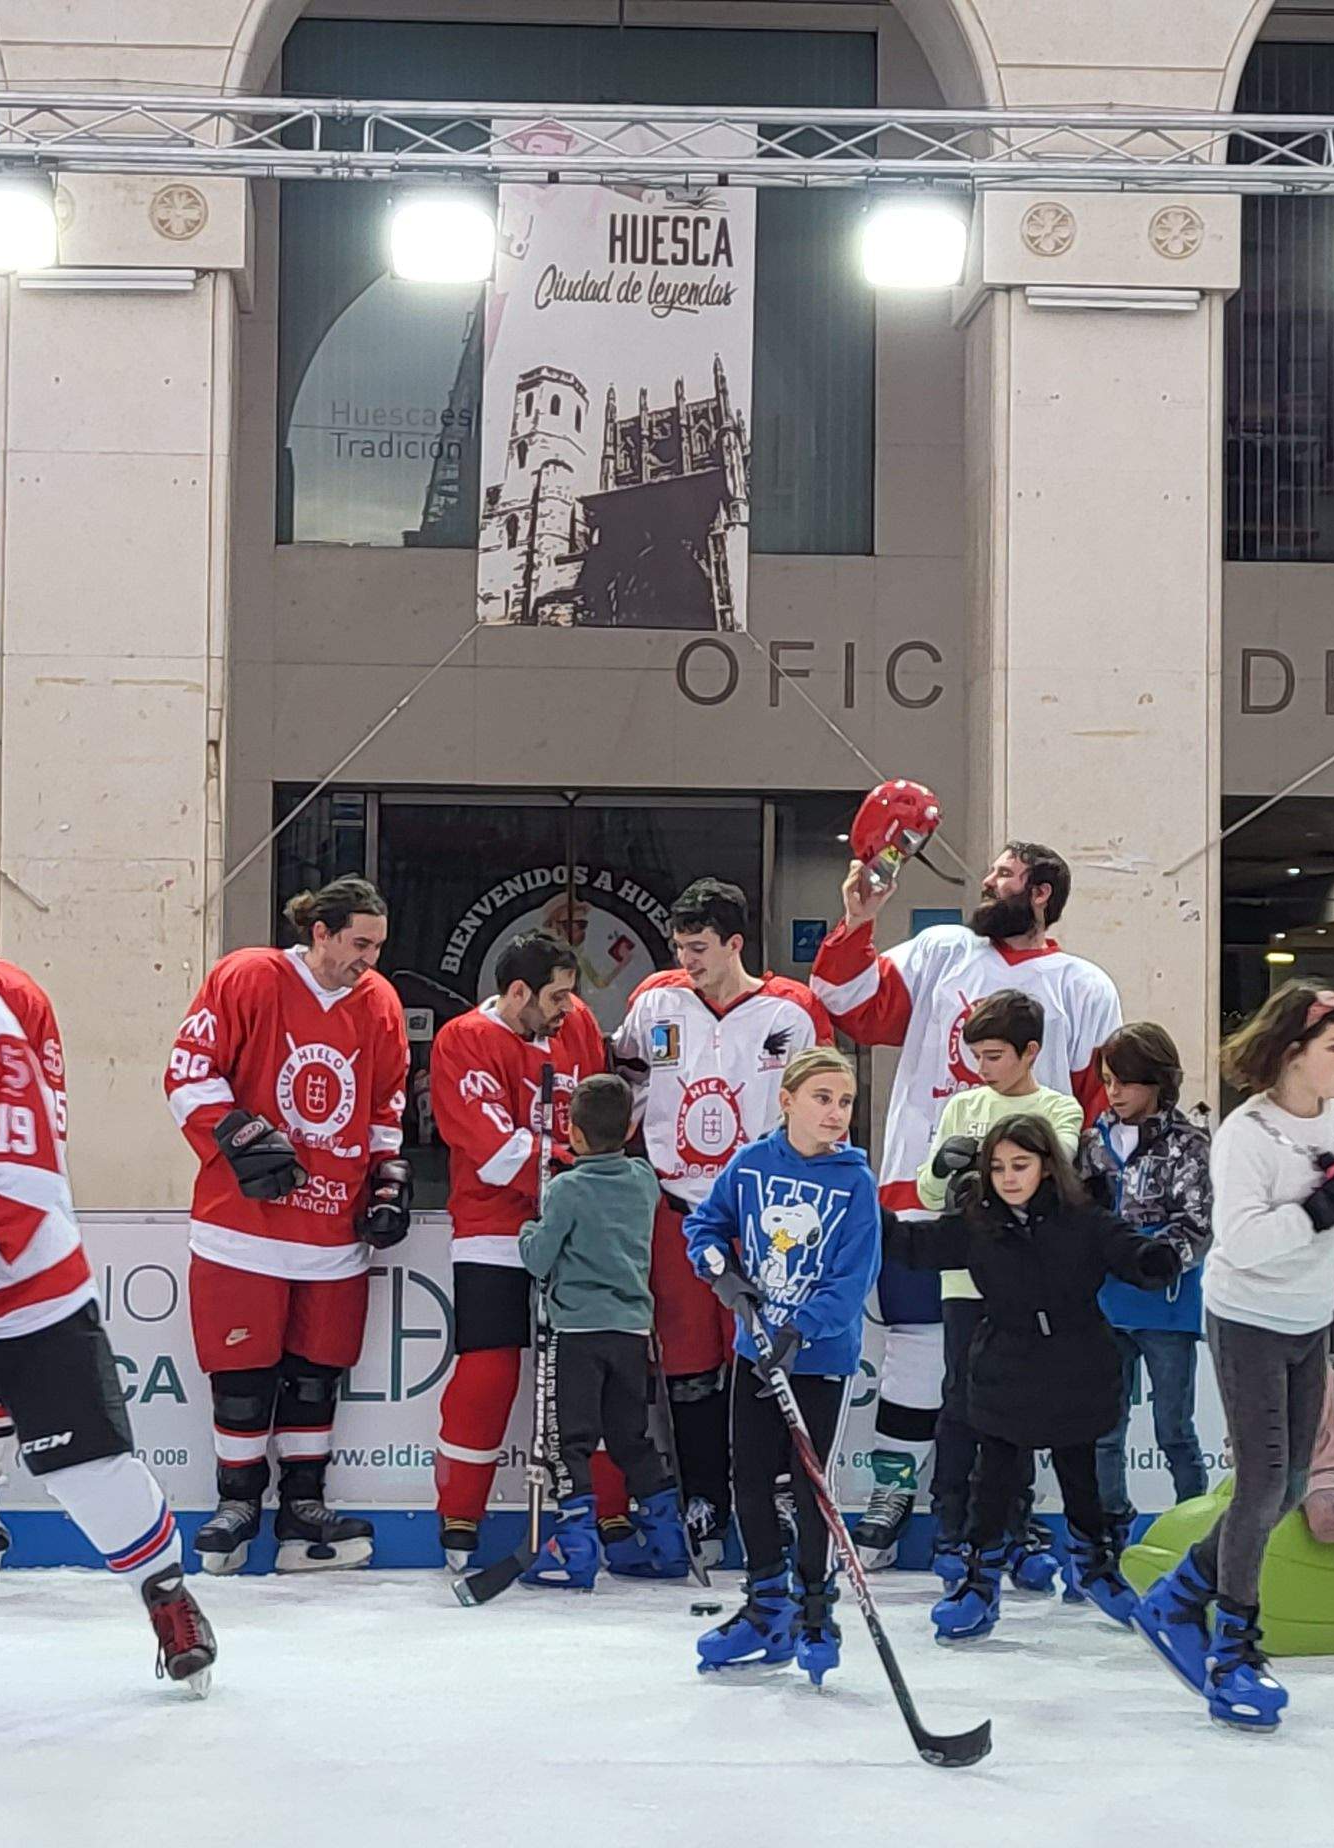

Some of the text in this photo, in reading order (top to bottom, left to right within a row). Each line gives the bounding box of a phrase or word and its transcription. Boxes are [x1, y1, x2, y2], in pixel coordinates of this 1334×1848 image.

[608, 213, 734, 268] HUESCA
[534, 263, 738, 319] Ciudad de leyendas
[675, 637, 944, 709] OFIC
[440, 865, 590, 975] BIENVENIDOS
[592, 869, 617, 893] A
[20, 1431, 74, 1455] CCM
[152, 1449, 189, 1467] 008
